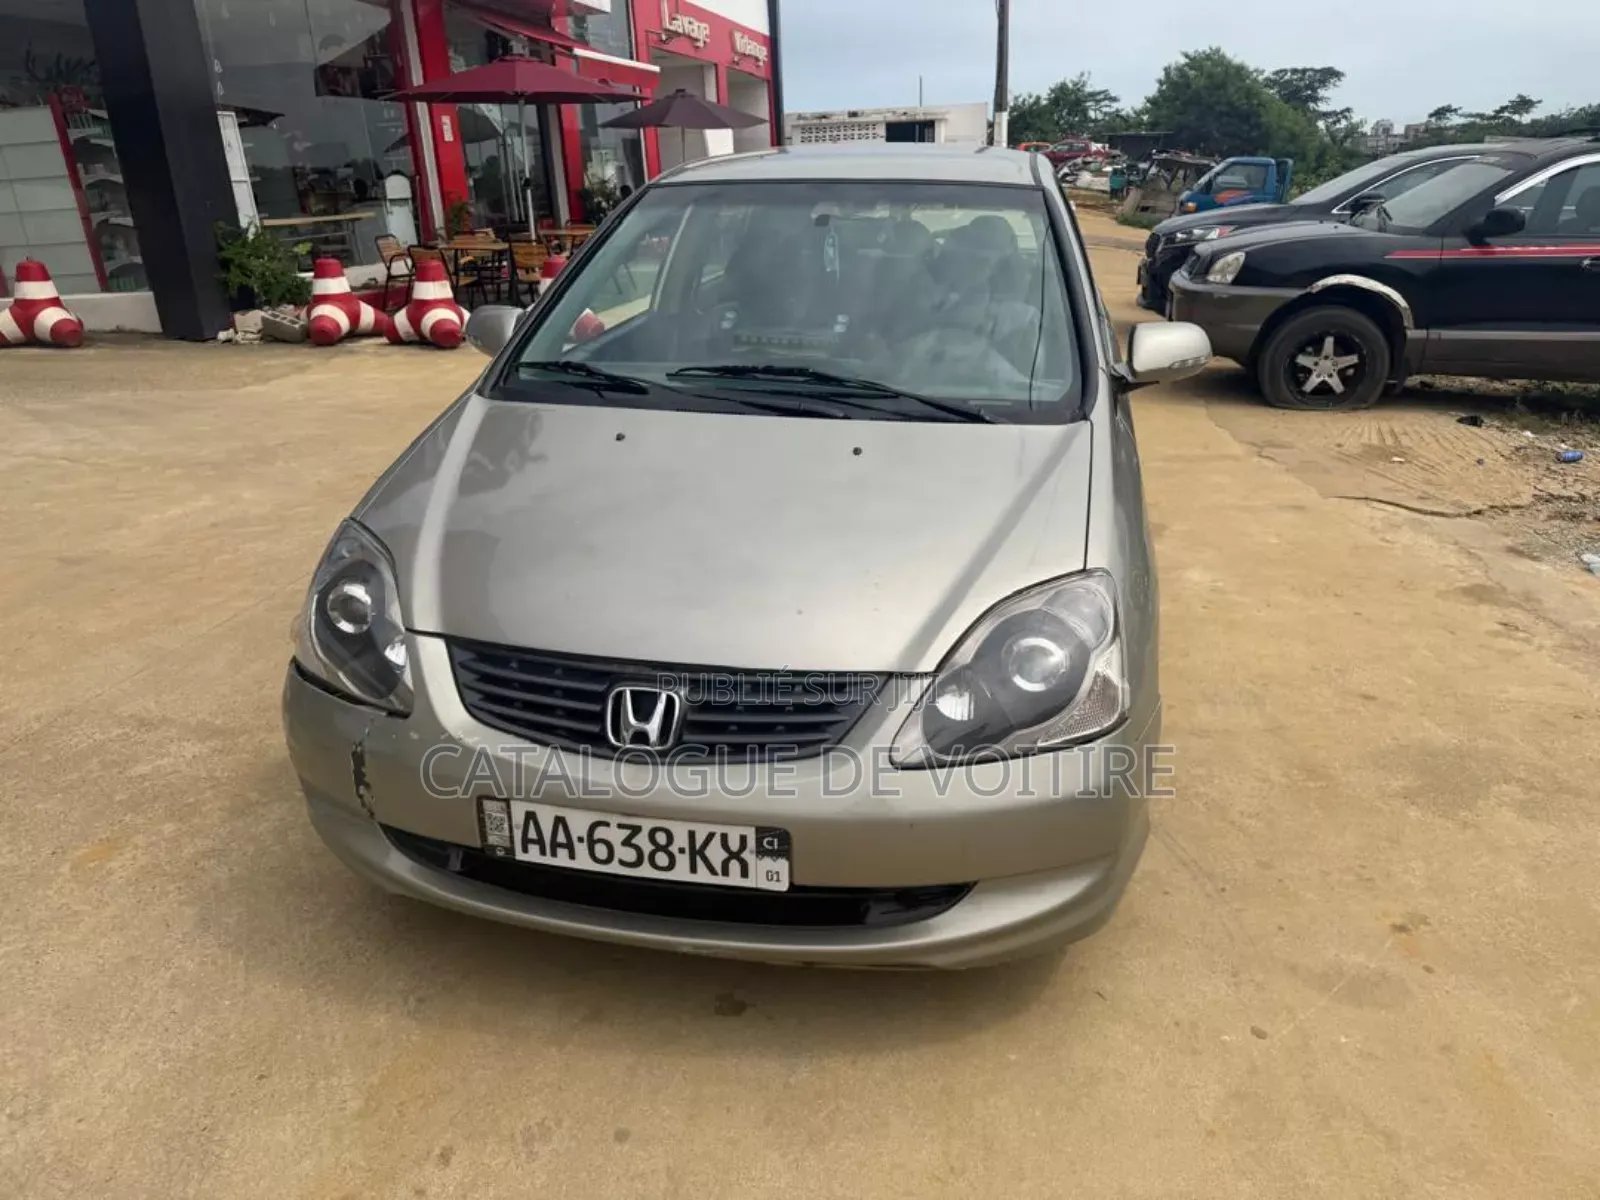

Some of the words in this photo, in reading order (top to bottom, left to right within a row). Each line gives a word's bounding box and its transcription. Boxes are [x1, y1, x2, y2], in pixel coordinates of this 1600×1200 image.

[661, 0, 710, 48] Lavage
[762, 836, 779, 850] CI
[765, 869, 781, 882] 01
